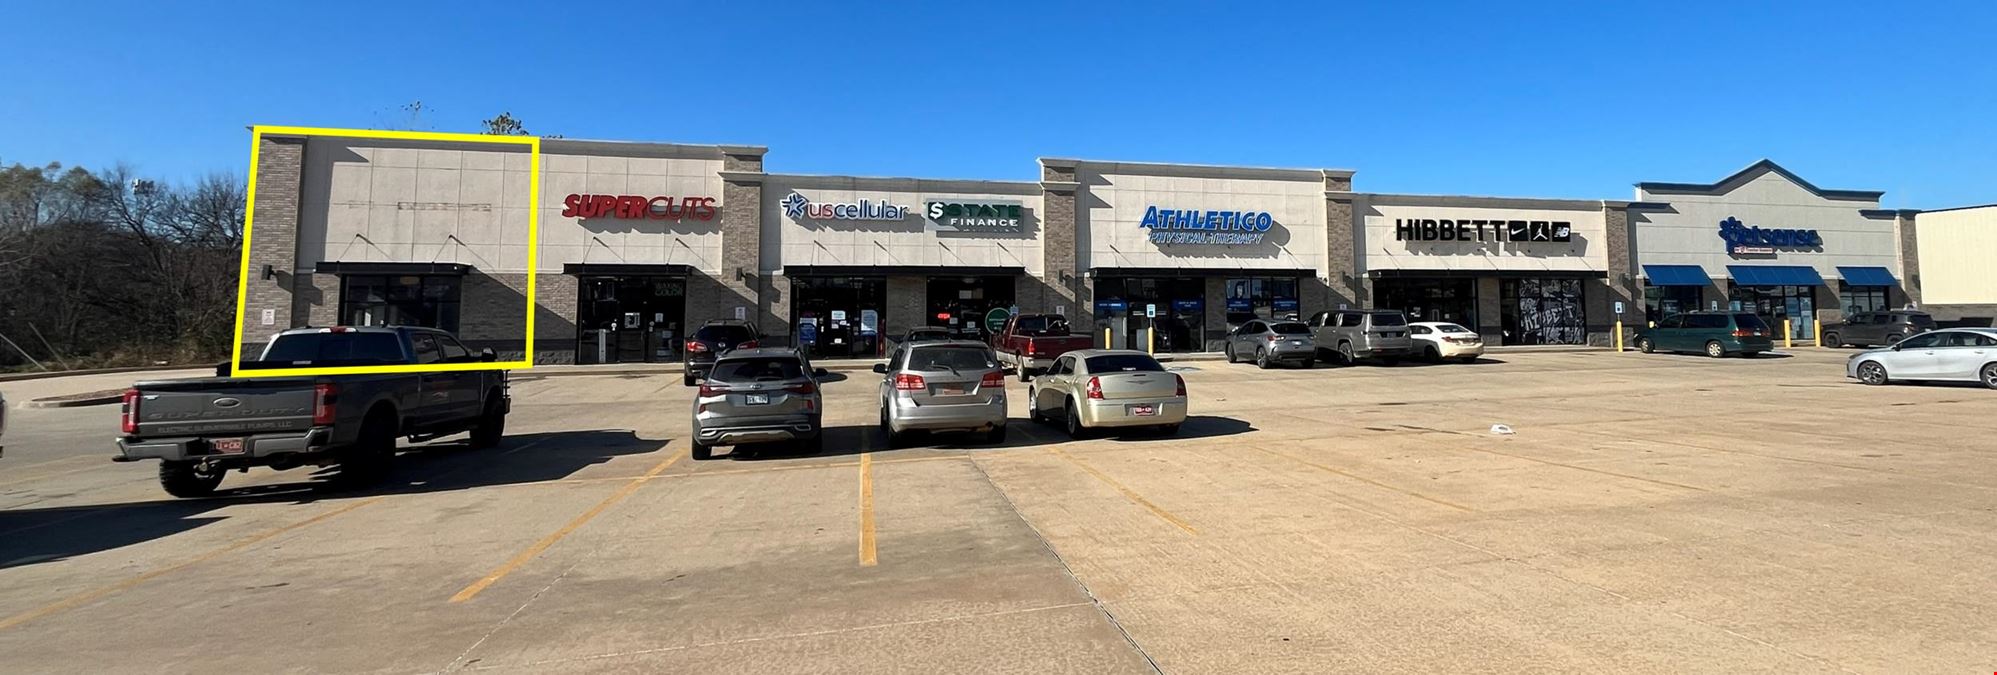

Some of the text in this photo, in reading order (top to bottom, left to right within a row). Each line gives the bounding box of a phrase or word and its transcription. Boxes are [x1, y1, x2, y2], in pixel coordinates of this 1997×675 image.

[562, 194, 716, 221] SUPERCUTS
[808, 199, 908, 219] uscellular
[950, 218, 1018, 227] FINANCE
[1140, 206, 1273, 231] ATHLETICO
[1150, 232, 1264, 245] PHYSICAL THERAPY
[1396, 218, 1506, 241] HIBBETT
